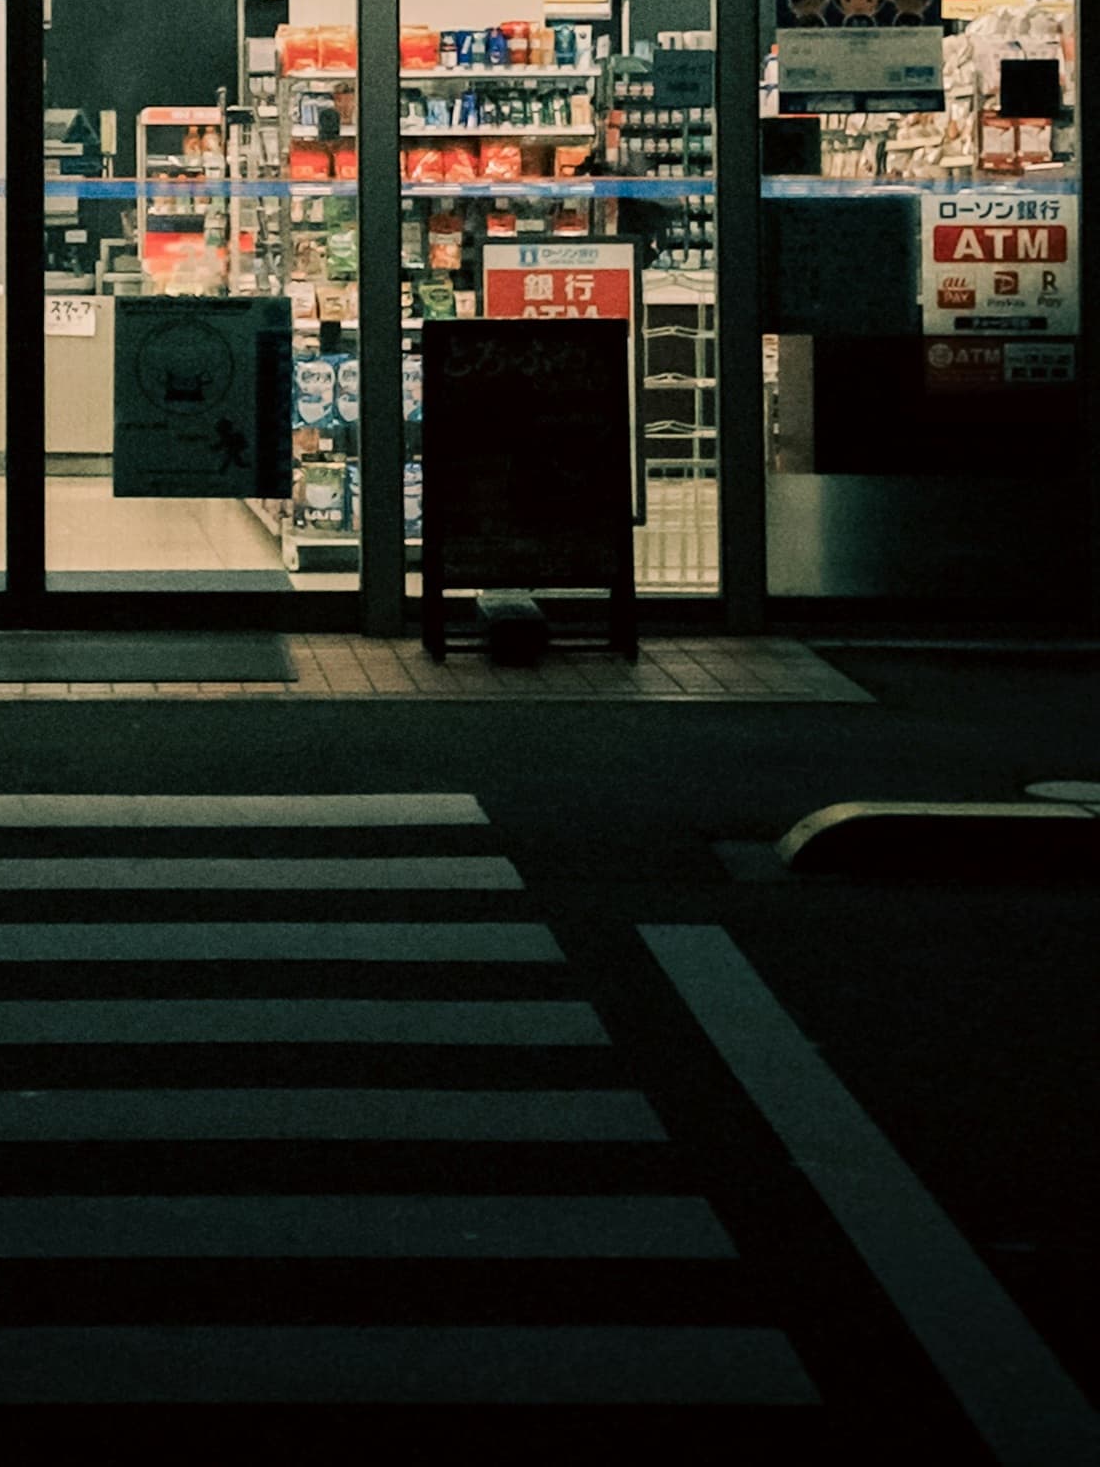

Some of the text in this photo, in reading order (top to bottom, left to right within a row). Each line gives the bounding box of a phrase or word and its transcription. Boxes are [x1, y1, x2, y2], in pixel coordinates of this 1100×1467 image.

[939, 200, 1061, 220] ローソン銀行
[953, 228, 1049, 259] ATM
[523, 274, 595, 301] 銀行
